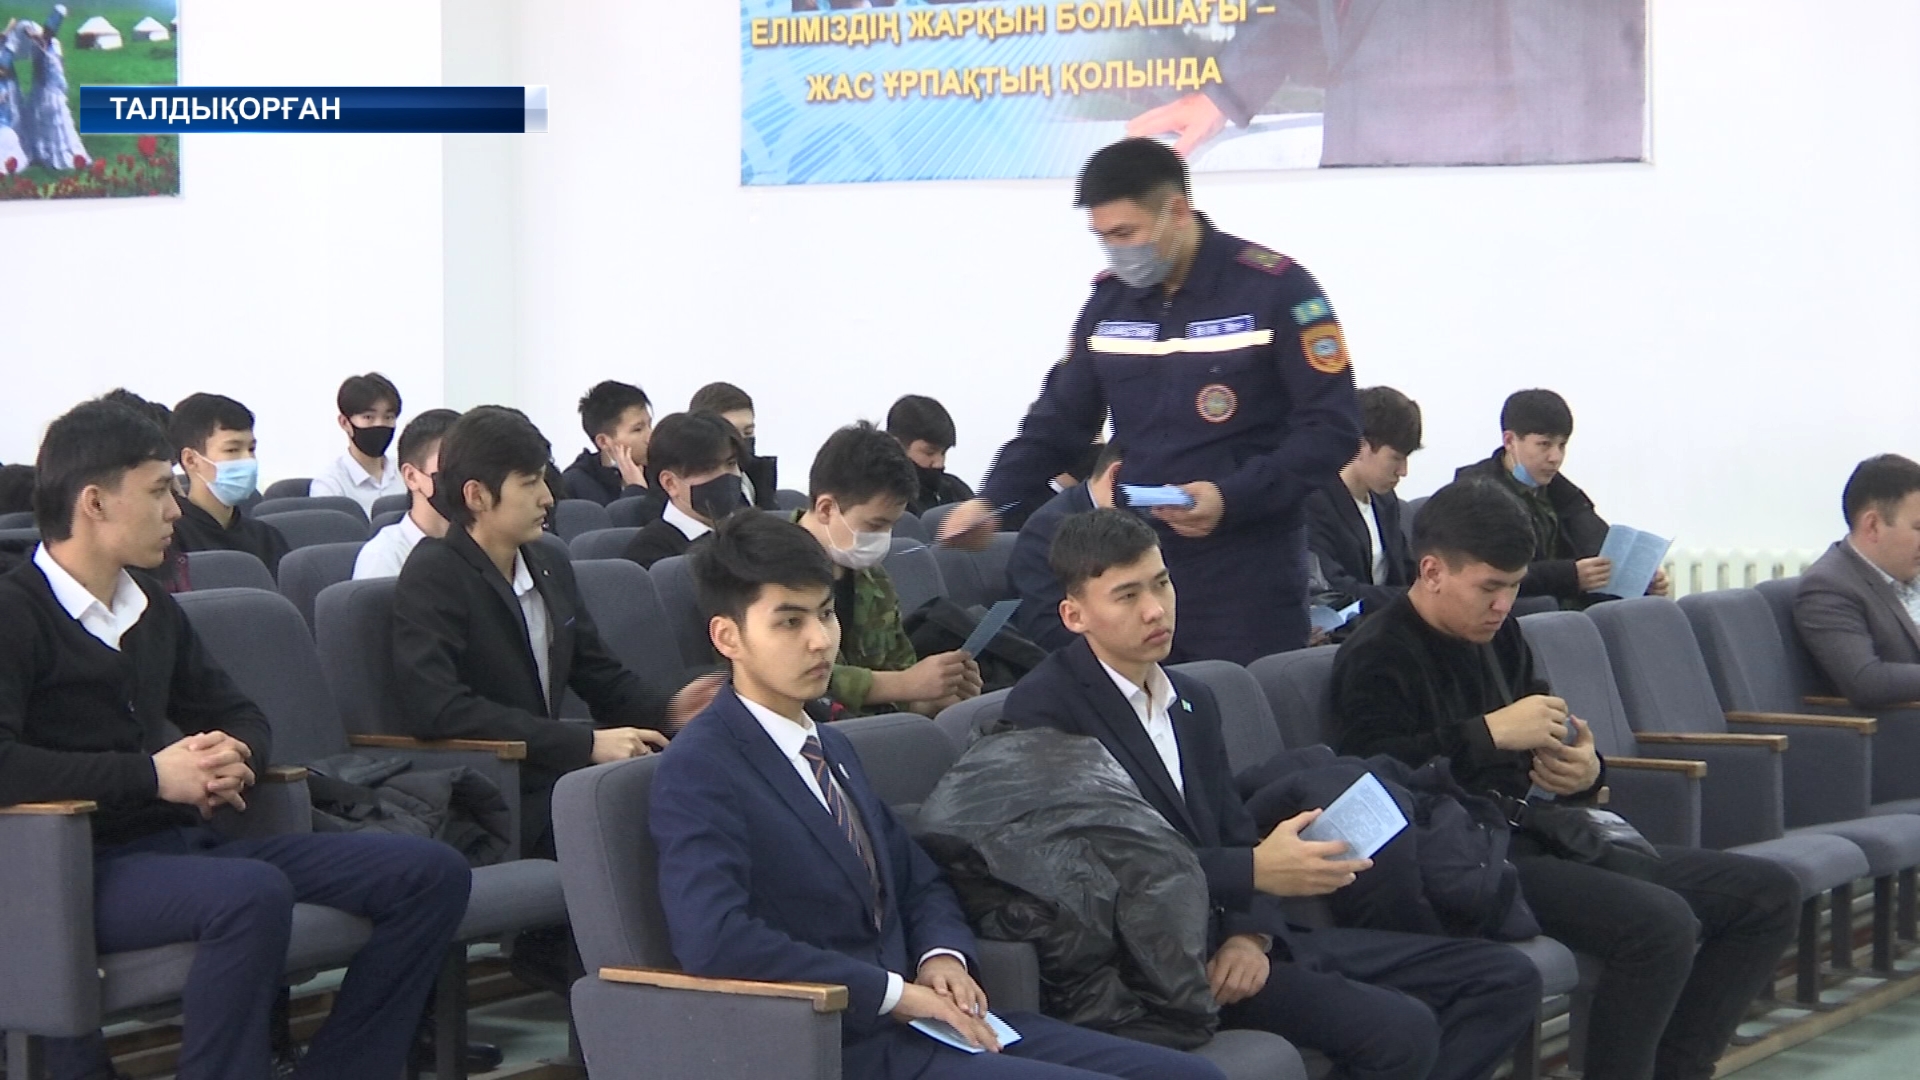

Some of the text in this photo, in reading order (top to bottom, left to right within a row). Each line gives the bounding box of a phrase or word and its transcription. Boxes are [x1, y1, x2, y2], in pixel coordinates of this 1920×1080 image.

[751, 14, 901, 47] ЕЛІМІЗДІҢ
[907, 7, 1047, 41] ЖАРҚЫН
[1056, 0, 1248, 31] БОЛАШАҒЫ
[807, 57, 1223, 102] ЖАС ҰРПАҚТЫҢ ҚОЛЫНДА
